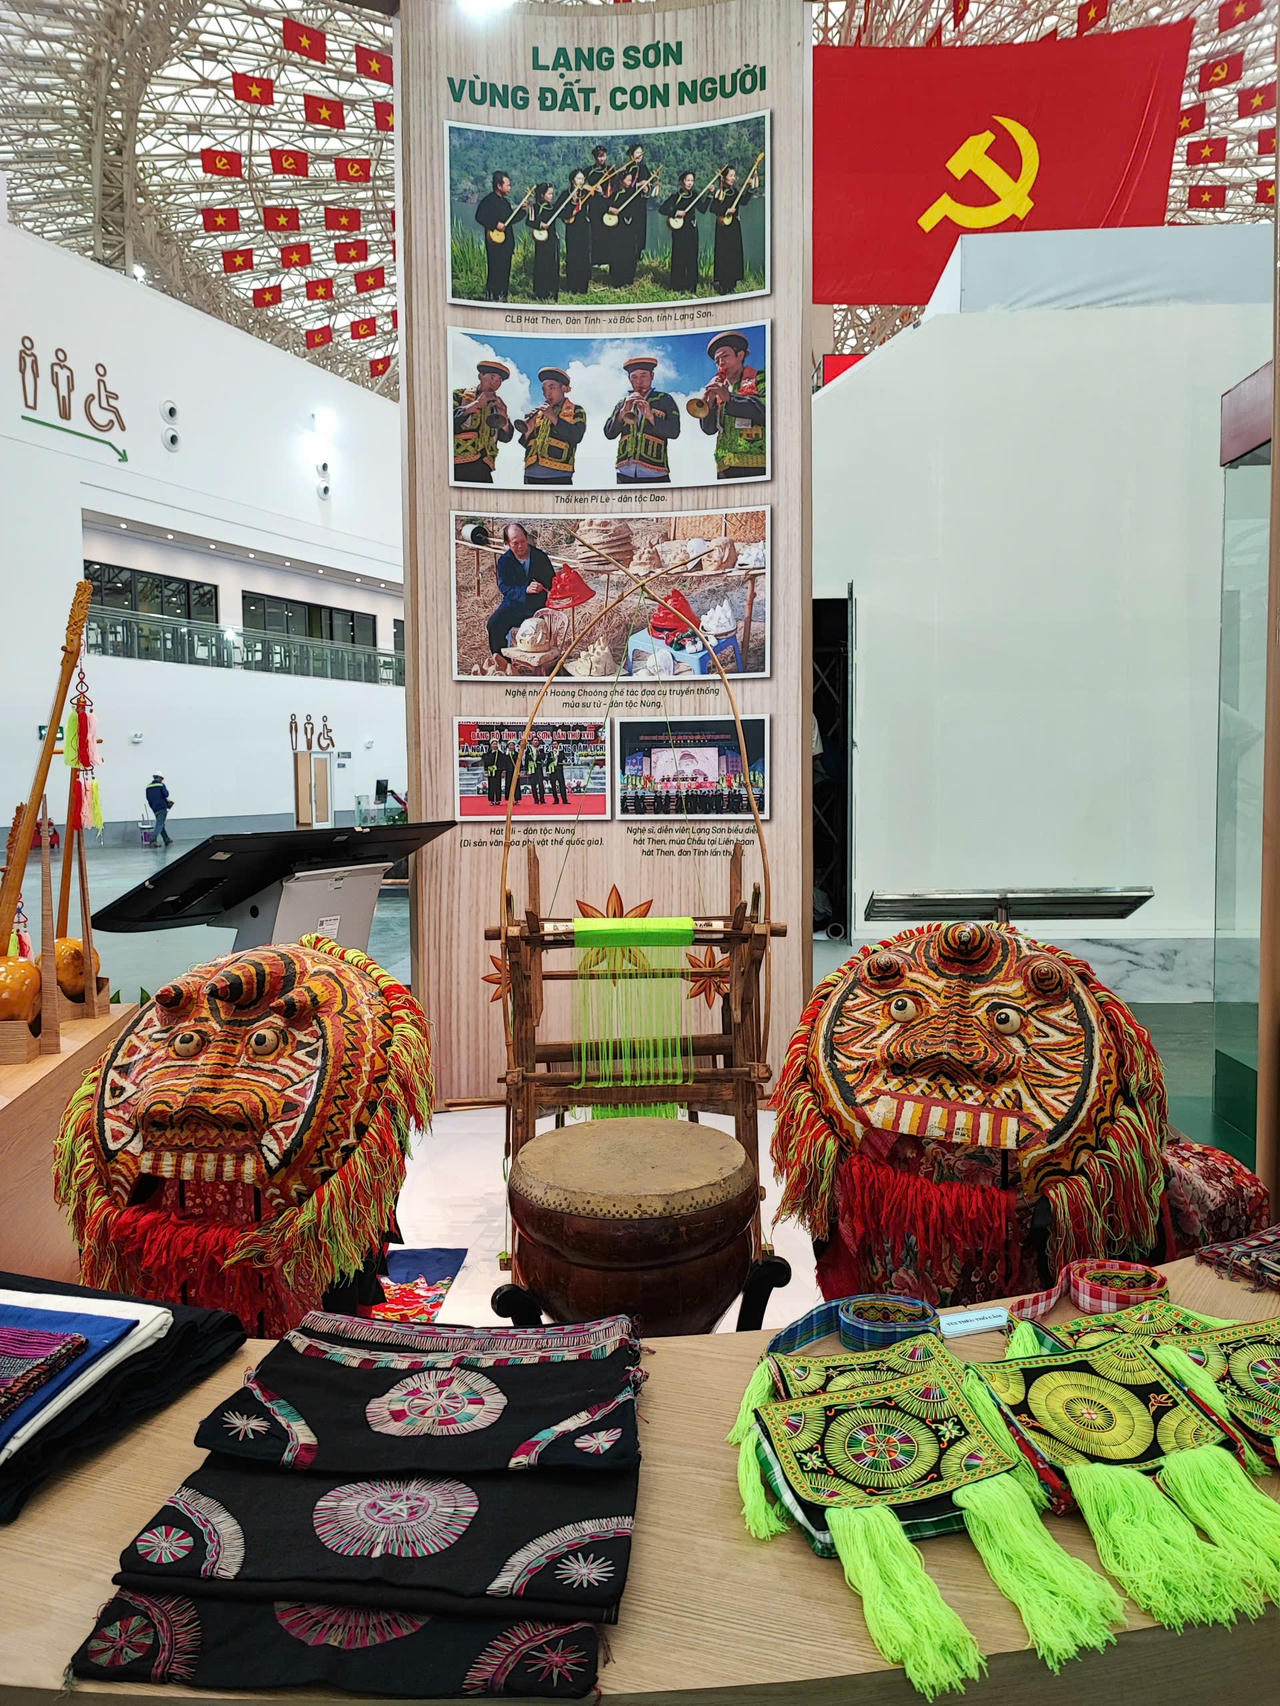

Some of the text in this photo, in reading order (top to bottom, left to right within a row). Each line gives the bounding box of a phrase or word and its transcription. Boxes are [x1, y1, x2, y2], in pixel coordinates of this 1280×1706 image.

[531, 40, 683, 79] LẠNG SƠN
[446, 64, 767, 115] VÙNG ĐẤT, CON NGƯỜI
[505, 314, 523, 324] CLB
[524, 315, 538, 324] Hát
[541, 316, 563, 325] Then,
[674, 312, 695, 323] Lạng
[617, 494, 633, 503] dân
[634, 495, 648, 505] tộc
[505, 688, 527, 699] Nghệ
[550, 688, 576, 698] Hoàng
[626, 700, 638, 710] tộc
[490, 827, 504, 836] Hát
[626, 826, 647, 836] Nghệ
[692, 826, 711, 836] Lạng
[632, 837, 646, 846] hát
[642, 848, 654, 857] hát
